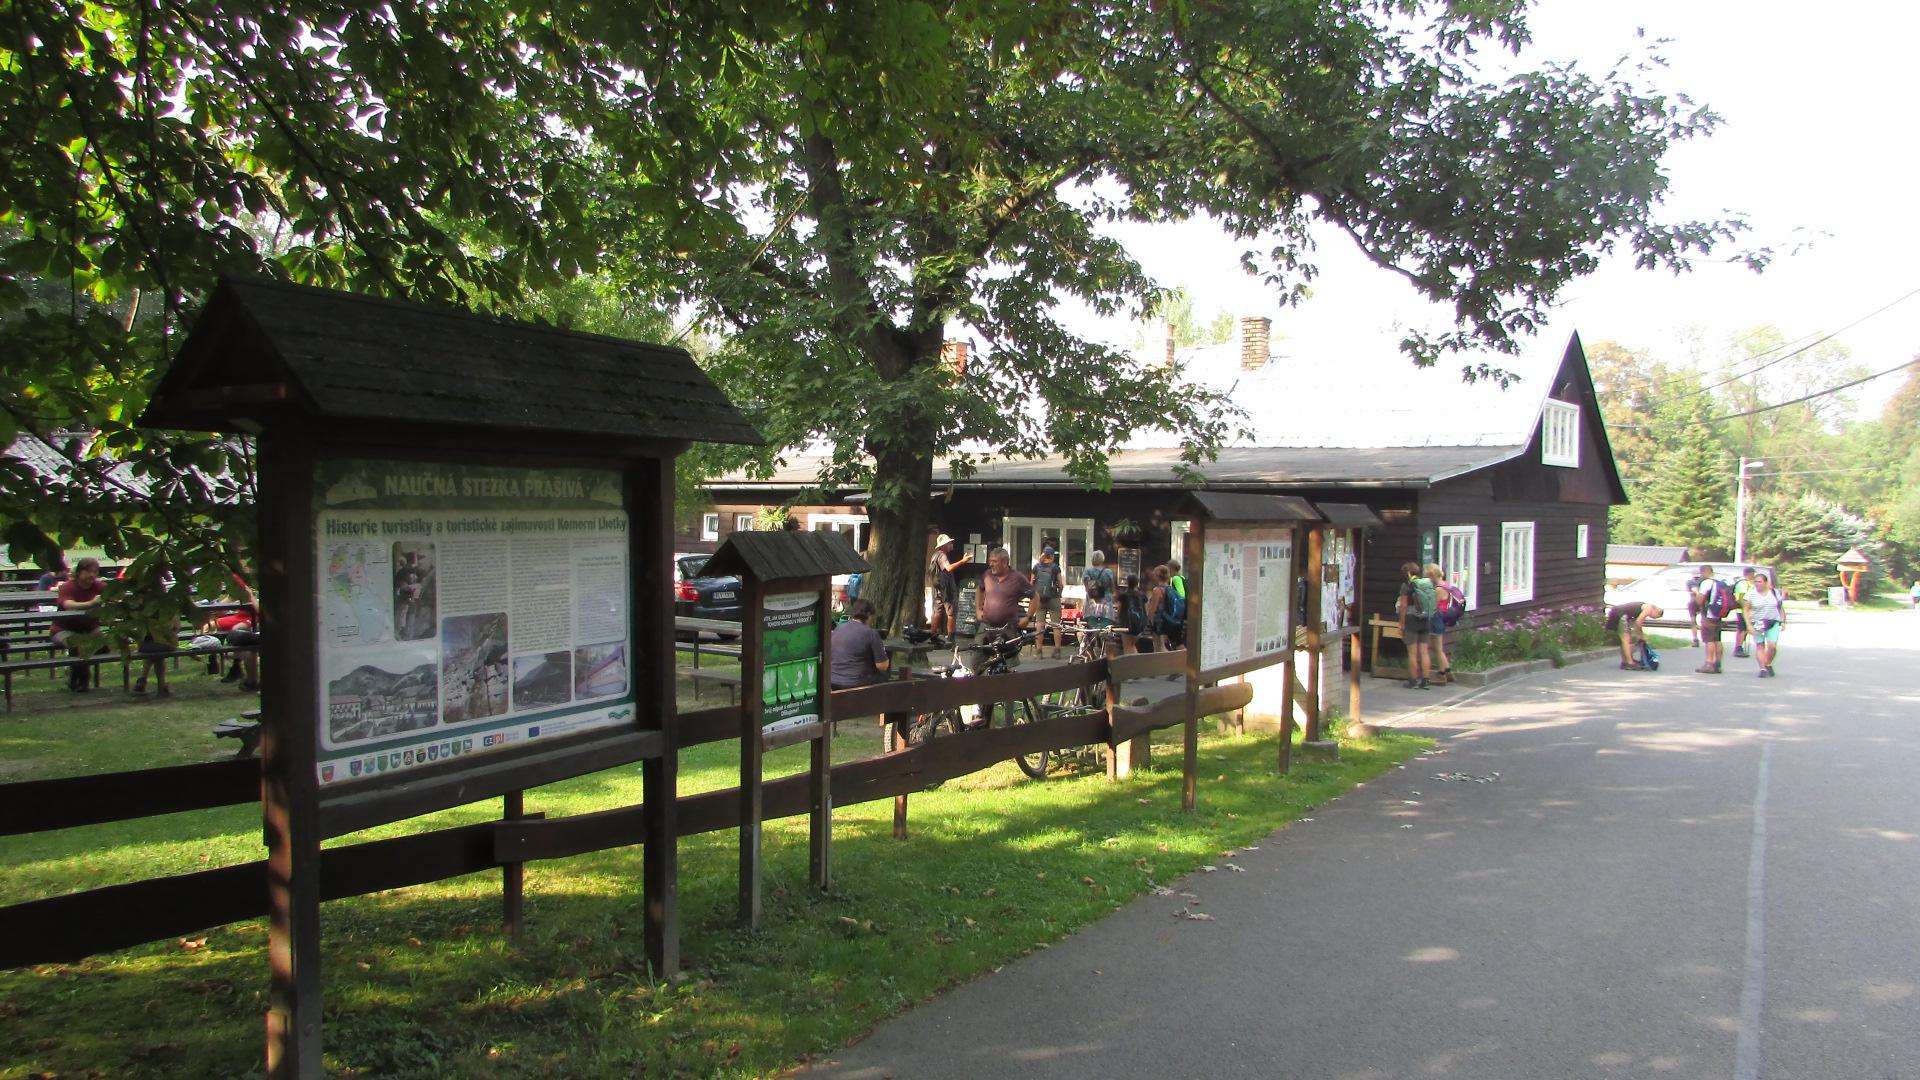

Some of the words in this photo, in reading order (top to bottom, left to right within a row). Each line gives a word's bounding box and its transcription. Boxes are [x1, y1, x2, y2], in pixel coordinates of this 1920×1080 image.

[384, 472, 458, 497] NAUČNÁ
[525, 476, 585, 499] PRAŠIVÁ
[326, 519, 378, 535] Historie
[382, 518, 433, 537] turistiky
[437, 522, 443, 533] a
[447, 516, 497, 533] turistické
[501, 517, 555, 534] zajímavosti
[557, 517, 596, 531] Komorní
[598, 516, 627, 532] Lhotky
